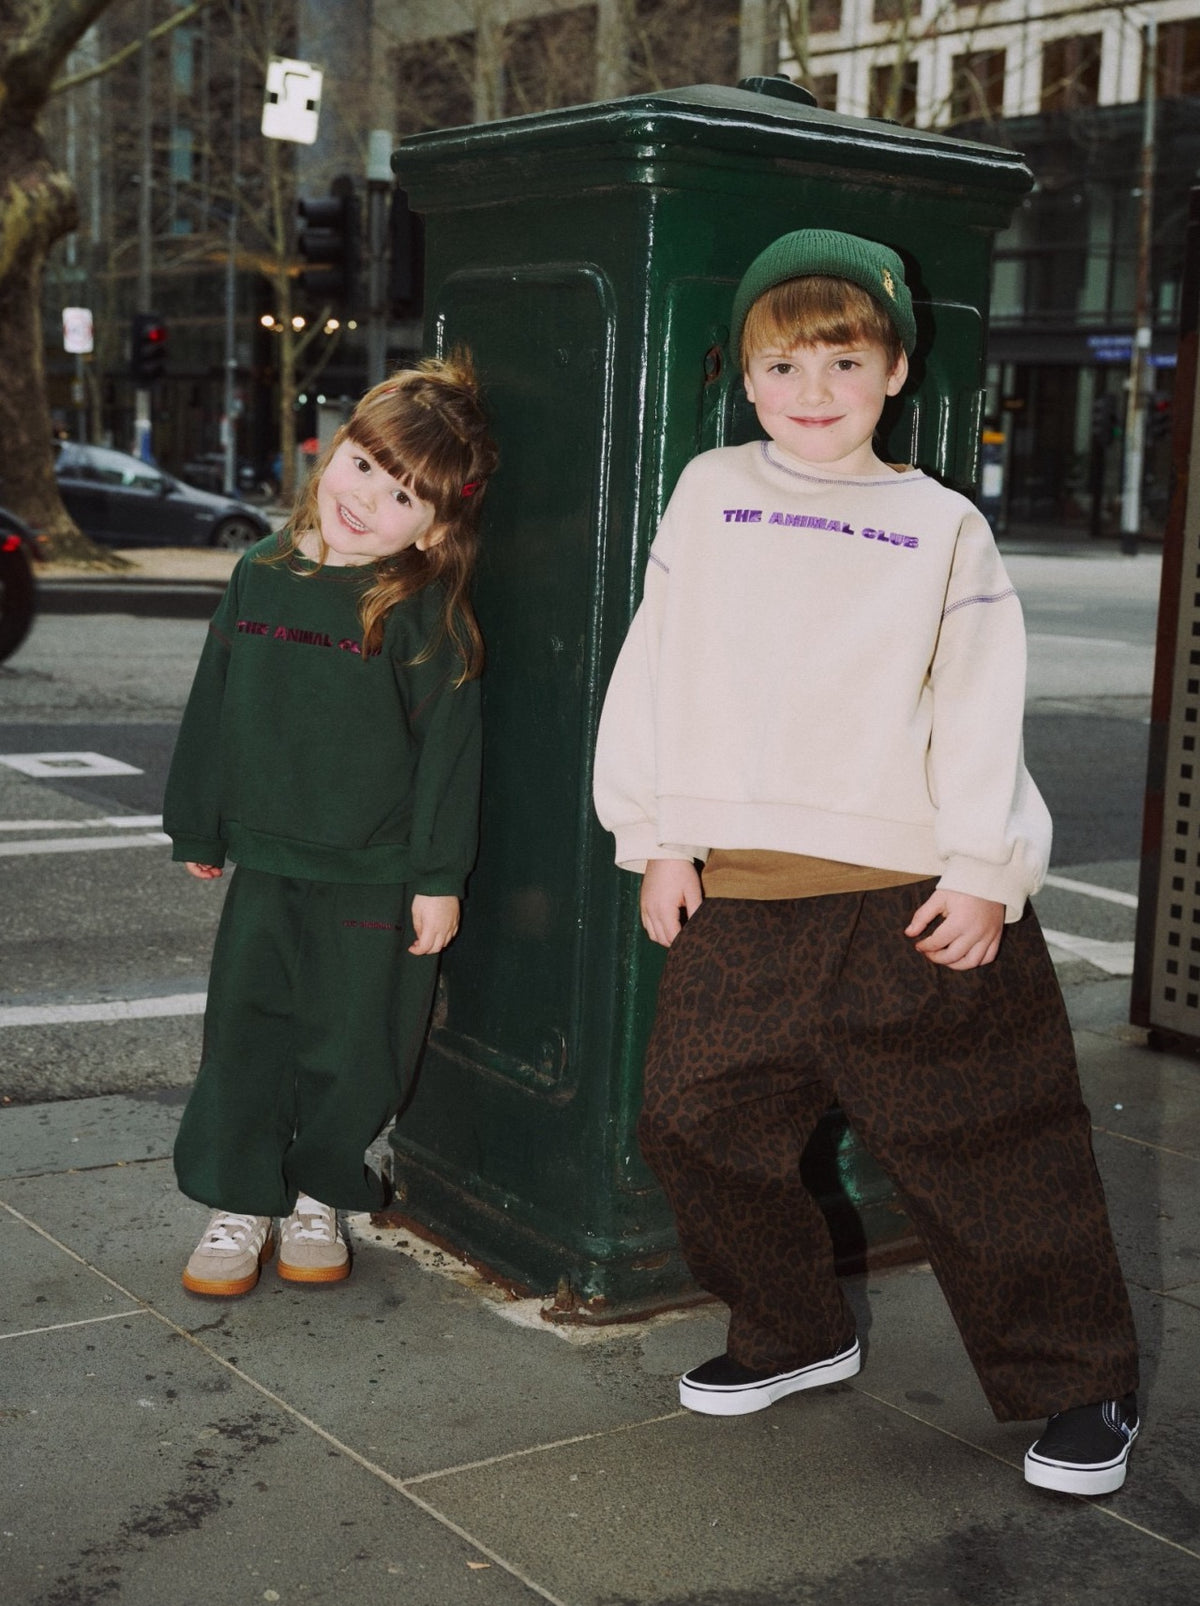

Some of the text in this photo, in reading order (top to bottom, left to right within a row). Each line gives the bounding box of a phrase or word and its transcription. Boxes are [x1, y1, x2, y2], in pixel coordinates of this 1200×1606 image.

[723, 509, 919, 549] THE ANIMAL CLUB
[236, 620, 382, 657] THE ANIMAL CL
